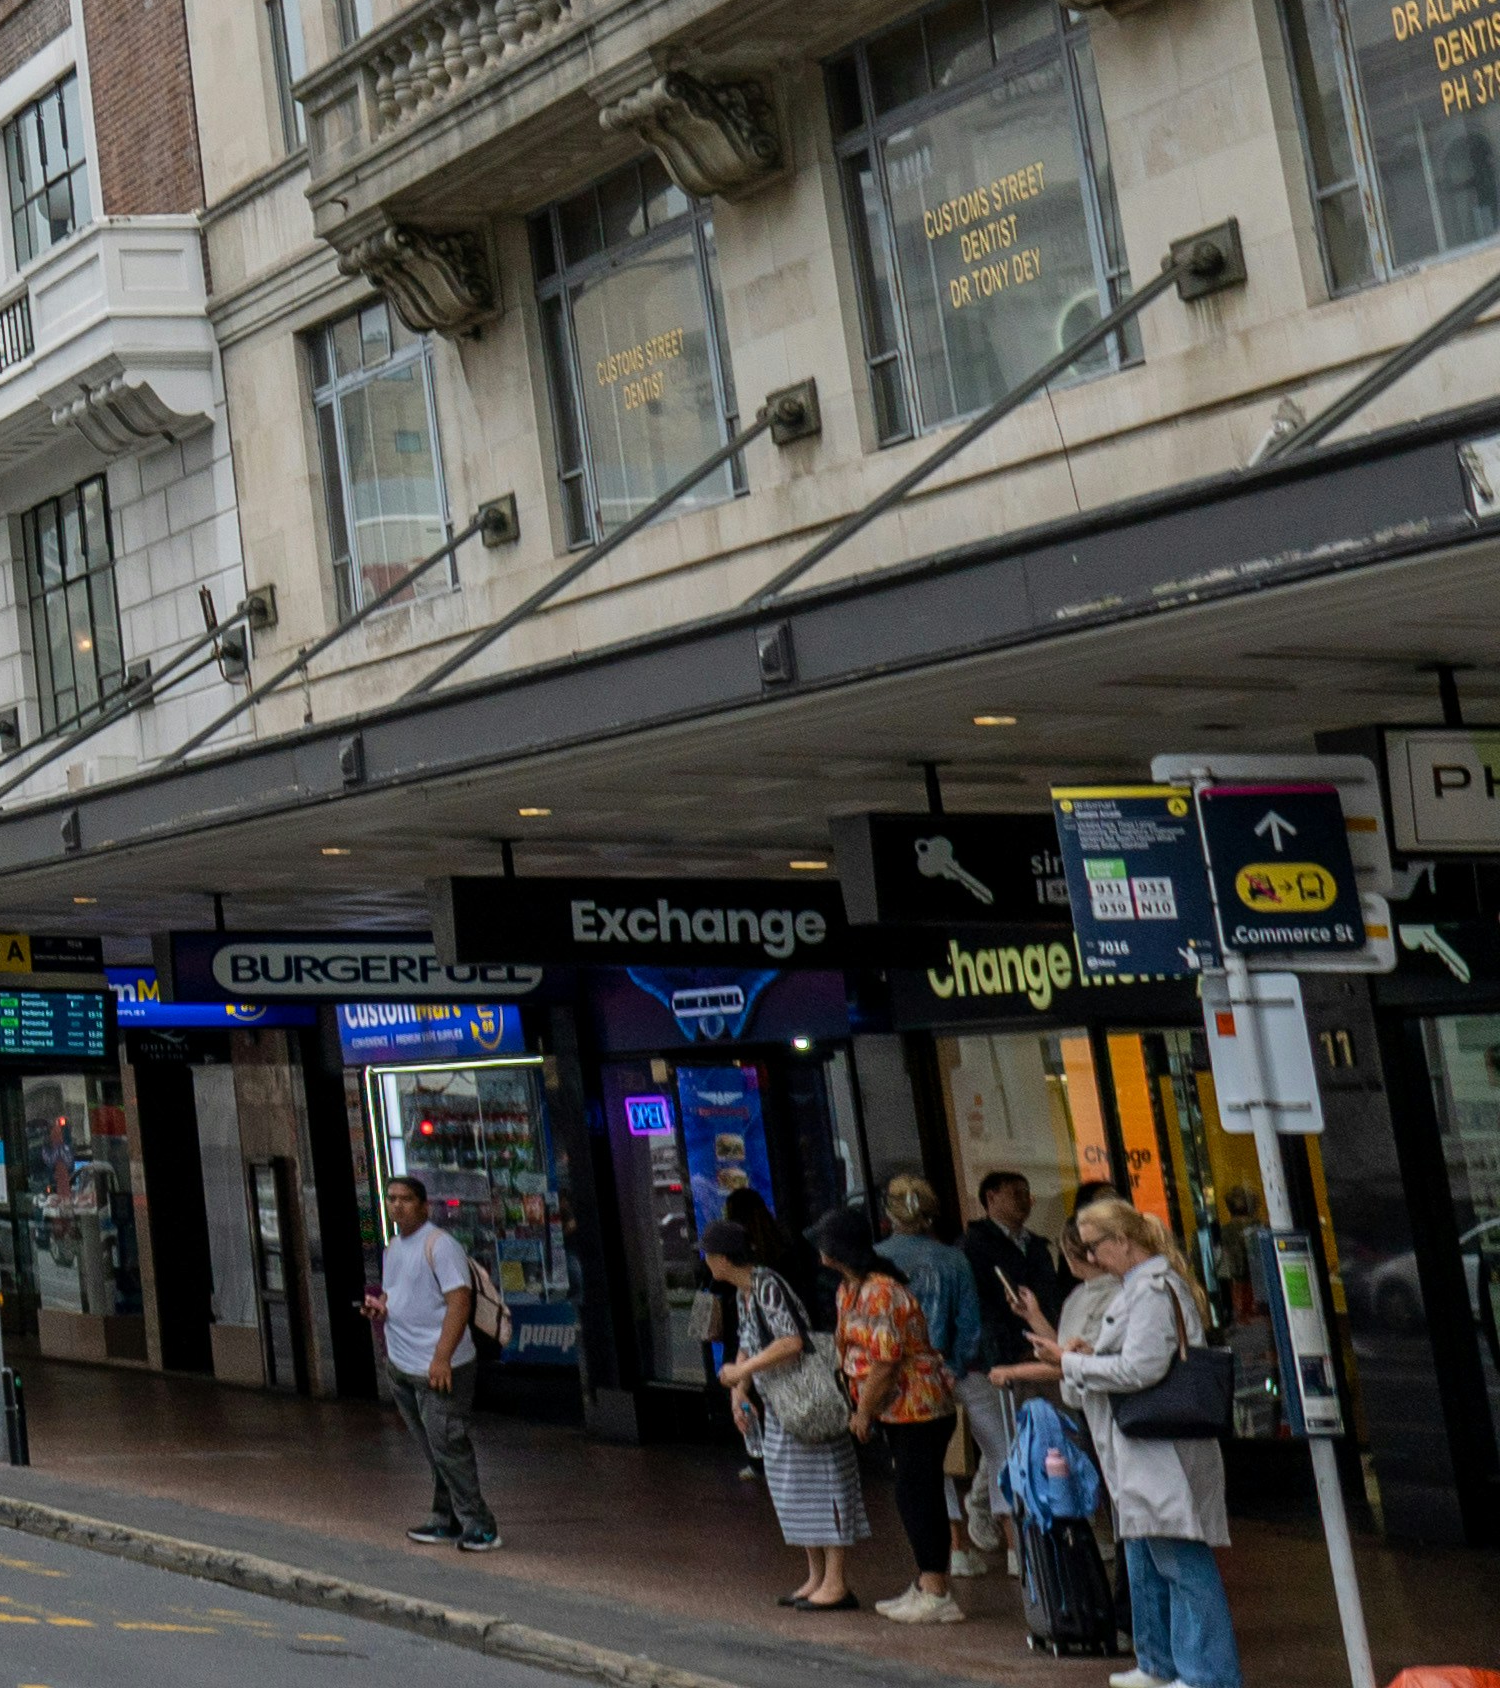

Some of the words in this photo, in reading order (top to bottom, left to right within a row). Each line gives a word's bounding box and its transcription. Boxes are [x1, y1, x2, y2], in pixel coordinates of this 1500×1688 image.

[1391, 0, 1423, 42] DR
[1440, 74, 1472, 118] PH
[923, 187, 989, 240] CUSTOMS
[991, 161, 1046, 213] STREET
[960, 215, 1018, 264] DENTIST
[950, 277, 971, 310] DR
[972, 258, 1013, 300] TONY
[1013, 248, 1042, 286] DEY
[596, 345, 645, 387] CUSTOMS
[645, 327, 685, 367] STREET
[623, 371, 666, 411] DENTIST
[1096, 883, 1122, 894] 931
[1138, 883, 1164, 894] 933
[1099, 902, 1127, 913] 939
[1141, 901, 1172, 912] N10
[570, 898, 827, 959] Exchange
[1098, 939, 1130, 955] 7016
[1235, 925, 1331, 944] Commerce
[1335, 925, 1354, 942] St
[7, 939, 26, 962] A
[230, 953, 534, 986] BURGERFUEL
[1320, 1030, 1354, 1069] 11
